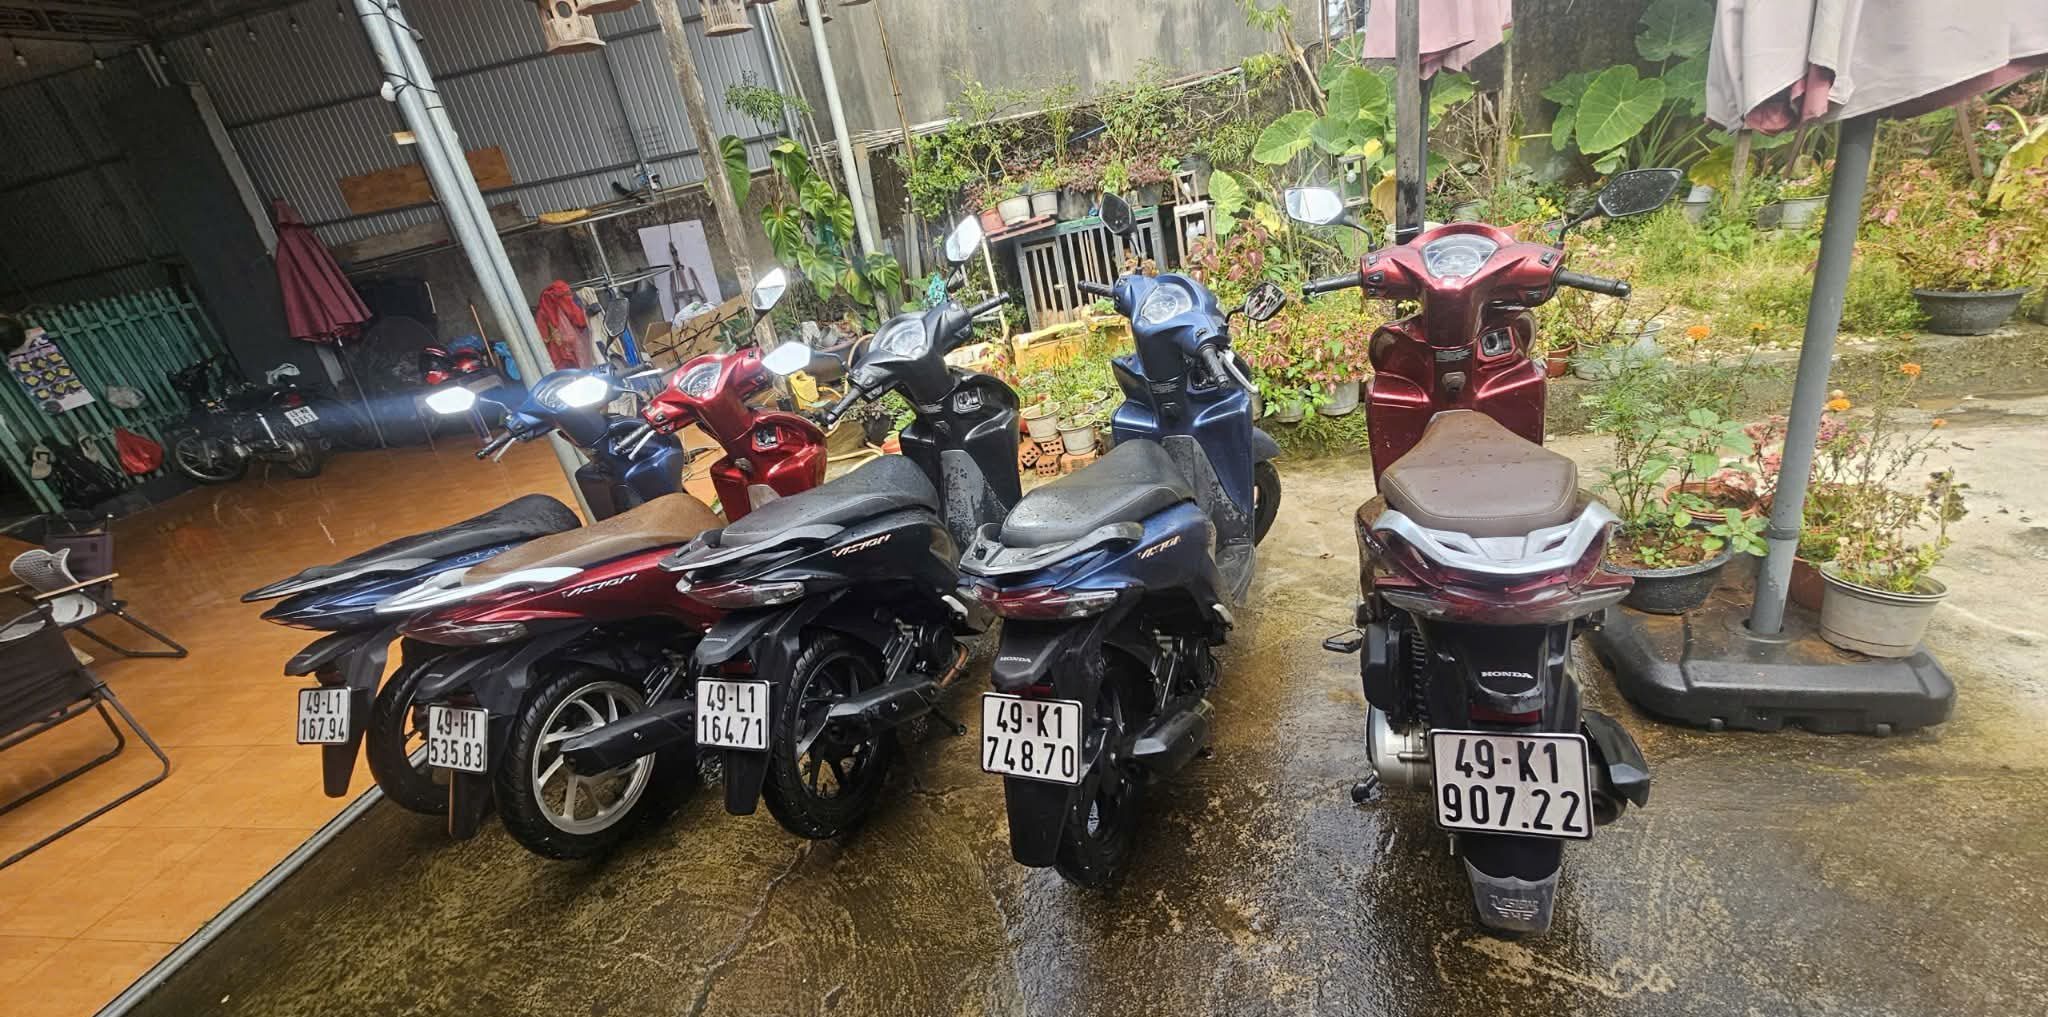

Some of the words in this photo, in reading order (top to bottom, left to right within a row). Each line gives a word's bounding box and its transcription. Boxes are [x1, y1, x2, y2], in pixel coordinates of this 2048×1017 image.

[1481, 671, 1534, 679] HONDA
[306, 691, 341, 715] 49-L1
[706, 684, 755, 713] 49-L1
[301, 717, 345, 741] 167.94
[436, 709, 476, 740] 49-H1
[701, 715, 763, 746] 164.71
[997, 701, 1062, 739] 49-K1
[430, 738, 484, 769] 535.83
[987, 736, 1075, 778] 748.70
[1455, 738, 1559, 784] 49-K1
[1442, 783, 1583, 833] 907.22
